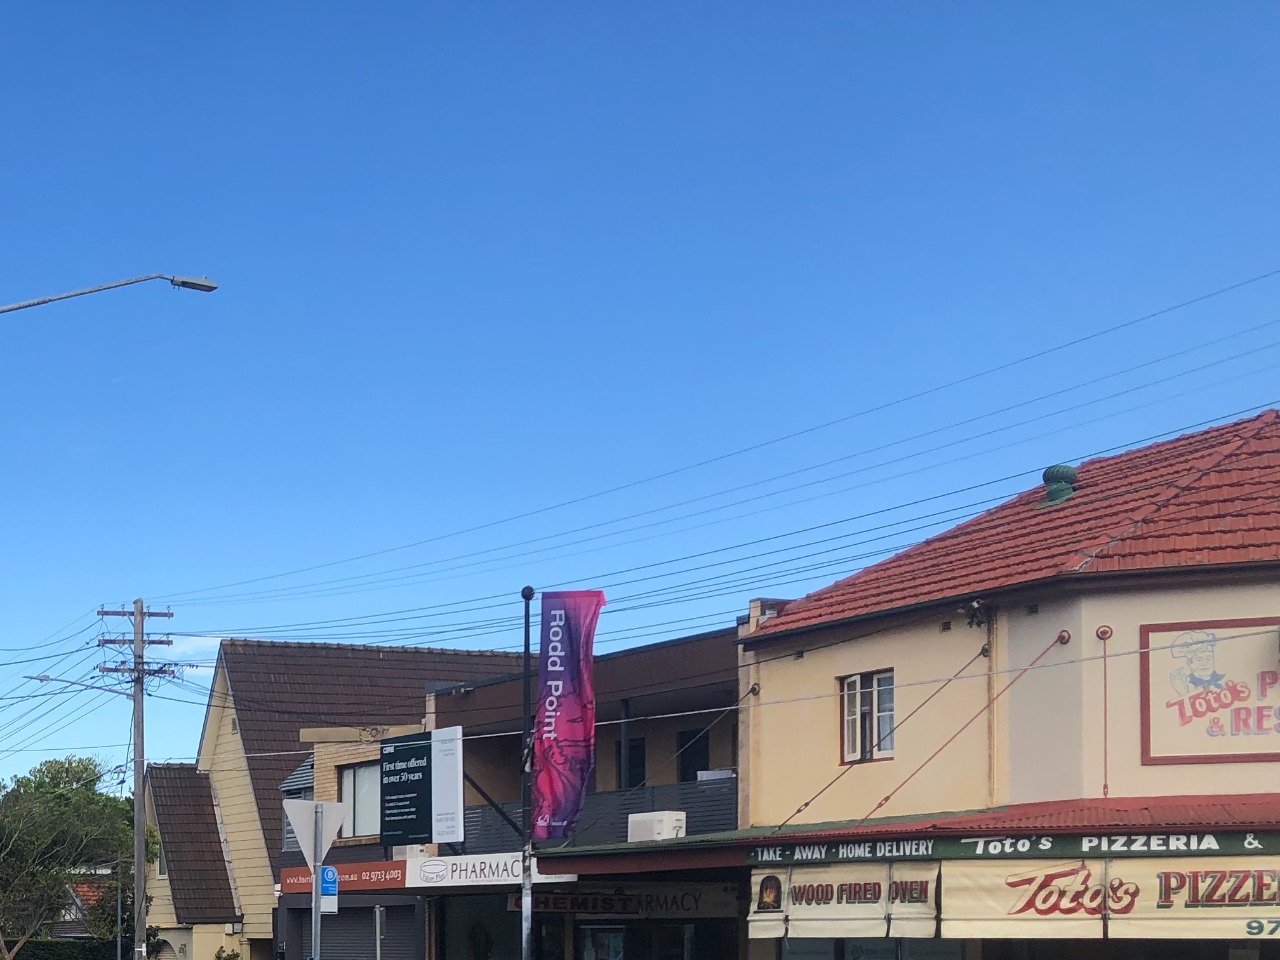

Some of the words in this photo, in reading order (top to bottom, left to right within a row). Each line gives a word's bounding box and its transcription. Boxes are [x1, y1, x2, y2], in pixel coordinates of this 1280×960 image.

[548, 609, 565, 671] Rodd
[543, 680, 563, 740] Point
[1206, 717, 1226, 737] &
[383, 762, 394, 772] First
[395, 760, 407, 770] time
[408, 756, 427, 768] offered
[383, 775, 389, 784] in
[389, 775, 400, 783] over
[408, 772, 423, 783] years
[756, 847, 783, 861] TAKE
[794, 845, 827, 860] AWAY
[838, 842, 873, 859] HOME
[876, 839, 935, 857] DELIVERY
[961, 835, 1053, 855] Toto's
[1081, 834, 1220, 852] PIZZERIA
[1243, 833, 1264, 849] &
[362, 871, 370, 880] 02
[371, 870, 385, 882] 9713
[451, 858, 530, 881] PHARMAC
[791, 883, 834, 905] WOOD
[837, 882, 882, 904] FIRED
[888, 880, 930, 904] OVEN
[1005, 860, 1140, 915] Toto's
